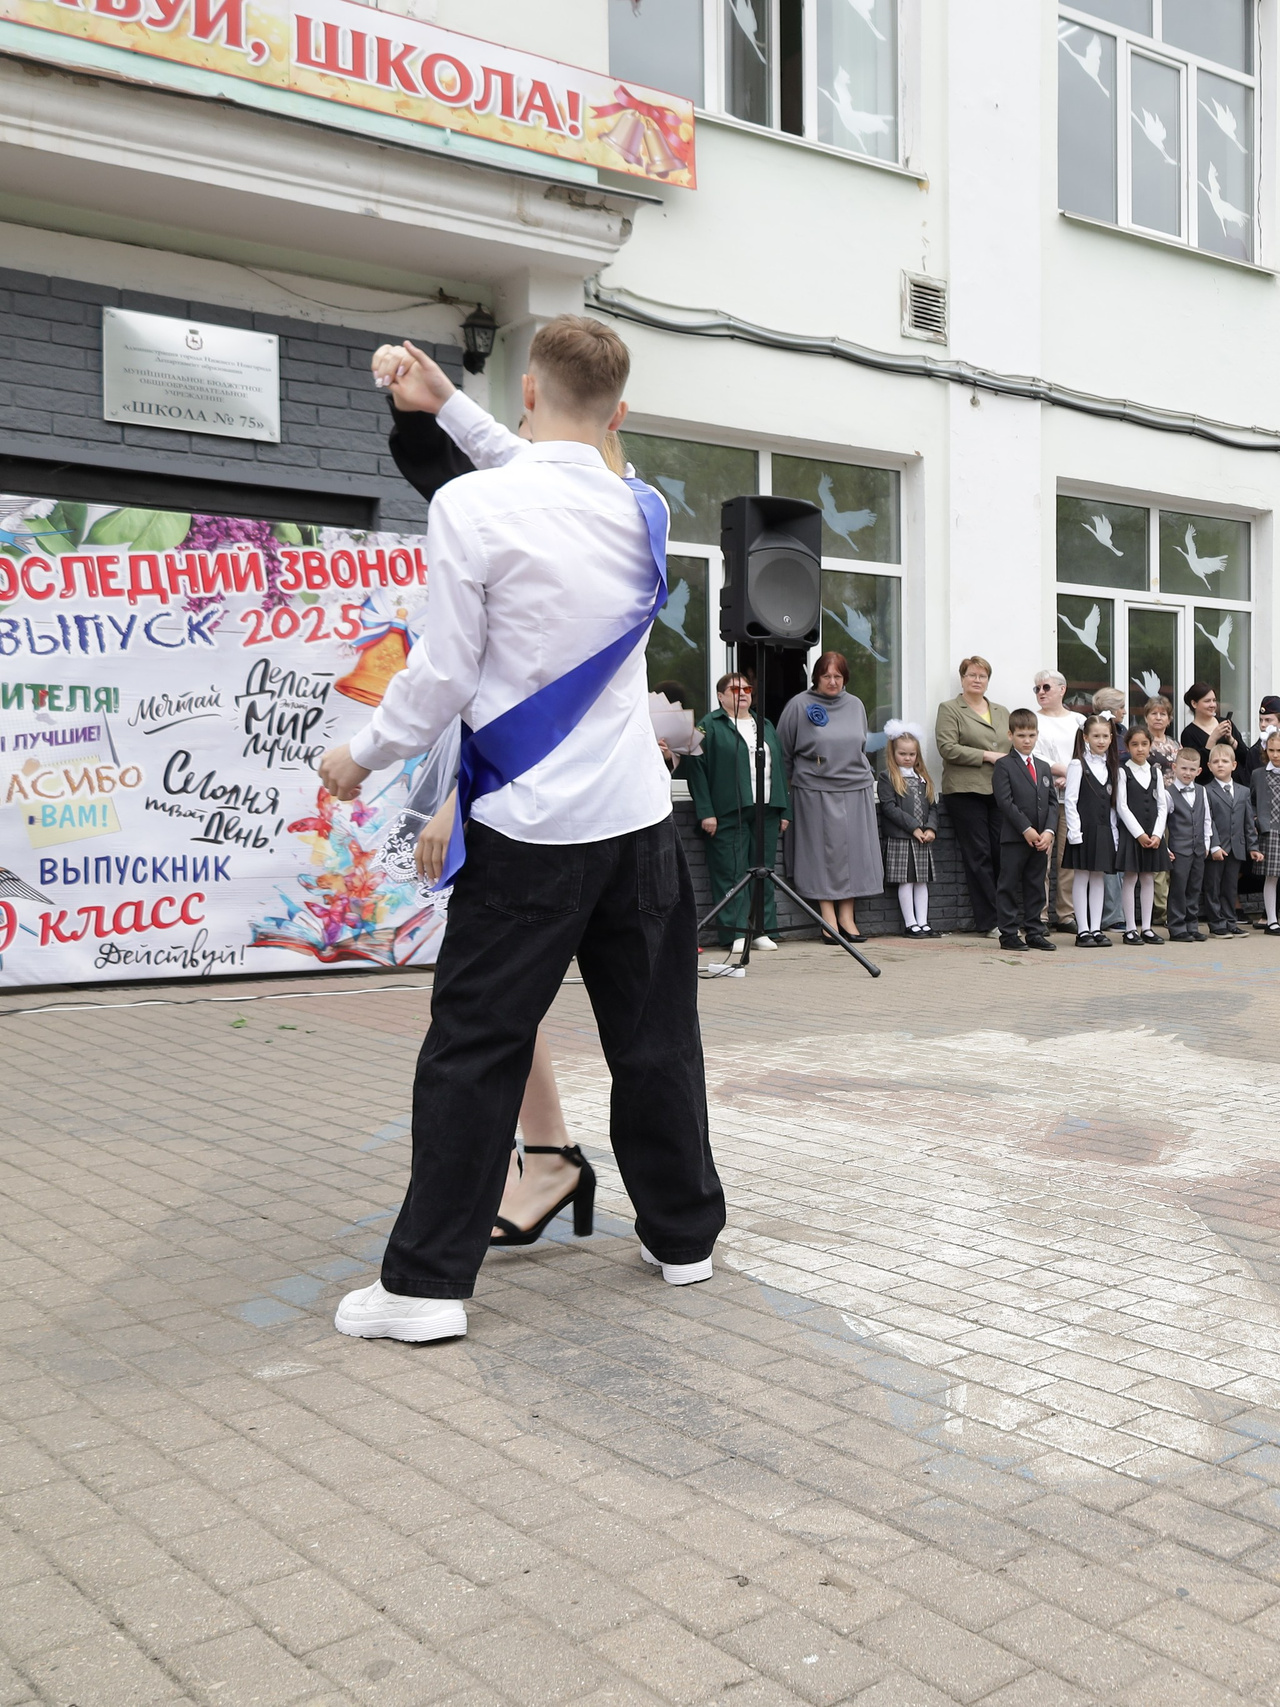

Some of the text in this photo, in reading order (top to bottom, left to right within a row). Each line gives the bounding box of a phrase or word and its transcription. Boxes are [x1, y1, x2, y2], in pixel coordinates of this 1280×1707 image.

[295, 14, 582, 137] ШКОЛА!
[123, 367, 264, 393] МУНИЦИПАЛЬНОЕ БЮДЖЕТНОЕ
[139, 378, 248, 398] ОБЩЕОБРАЗОВАТЕЛЬНОЕ
[164, 389, 225, 403] УЧРЕЖДЕНИЕ
[122, 400, 265, 430] «ШКОЛА № 75»
[0, 545, 264, 605] ОСЛЕДНИЙ
[0, 604, 363, 656] ВЫПУСК 2025
[0, 681, 120, 714] ИТЕЛЯ!
[235, 657, 335, 708] Делай
[128, 684, 225, 726] Мечтай
[245, 700, 324, 744] Мир
[13, 725, 102, 751] ЛУЧШИЕ!
[5, 765, 143, 804] АСИБО
[163, 749, 280, 815] Сегодня
[41, 804, 108, 829] ВАМ!
[145, 796, 285, 854] твой День!
[39, 854, 232, 886] ВЫПУСКНИК
[38, 891, 206, 947] класс
[94, 928, 246, 976] Действуй!
